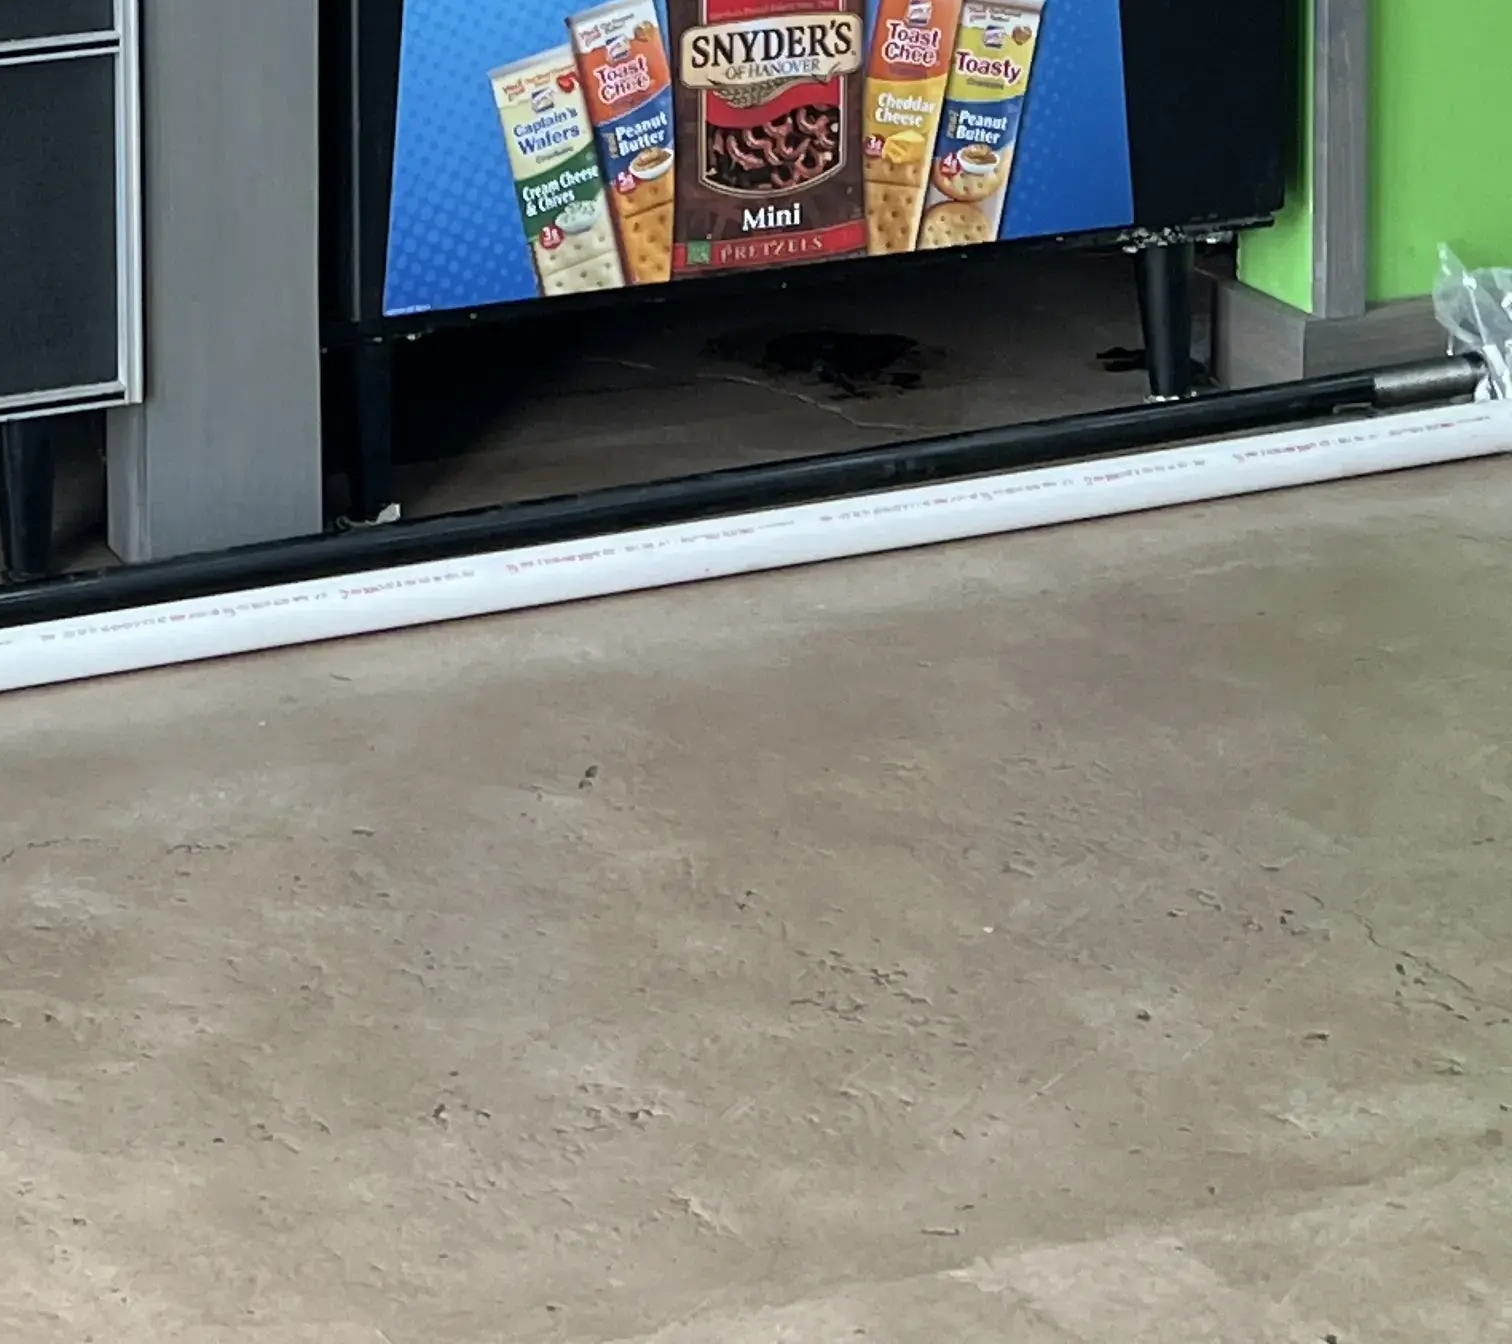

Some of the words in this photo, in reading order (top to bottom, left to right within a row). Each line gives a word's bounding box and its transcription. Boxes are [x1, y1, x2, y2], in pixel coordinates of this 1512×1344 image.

[691, 19, 854, 70] SNYDER'S
[888, 22, 939, 48] Toast
[884, 41, 935, 65] Chee
[955, 49, 1021, 84] Toasty
[596, 55, 648, 85] Toast
[725, 64, 747, 80] OF
[749, 59, 820, 79] HANOVER
[878, 92, 936, 113] Cheddar
[513, 107, 578, 138] Captain's
[615, 111, 668, 141] Peanut
[875, 109, 924, 128] Cheese
[958, 110, 1008, 130] Peanut
[517, 125, 580, 155] Wafers
[618, 128, 666, 157] Butter
[956, 124, 1001, 144] Butter
[522, 174, 559, 202] Cream
[558, 163, 599, 188] Cheese
[538, 188, 576, 214] Chives
[742, 202, 802, 231] Mini
